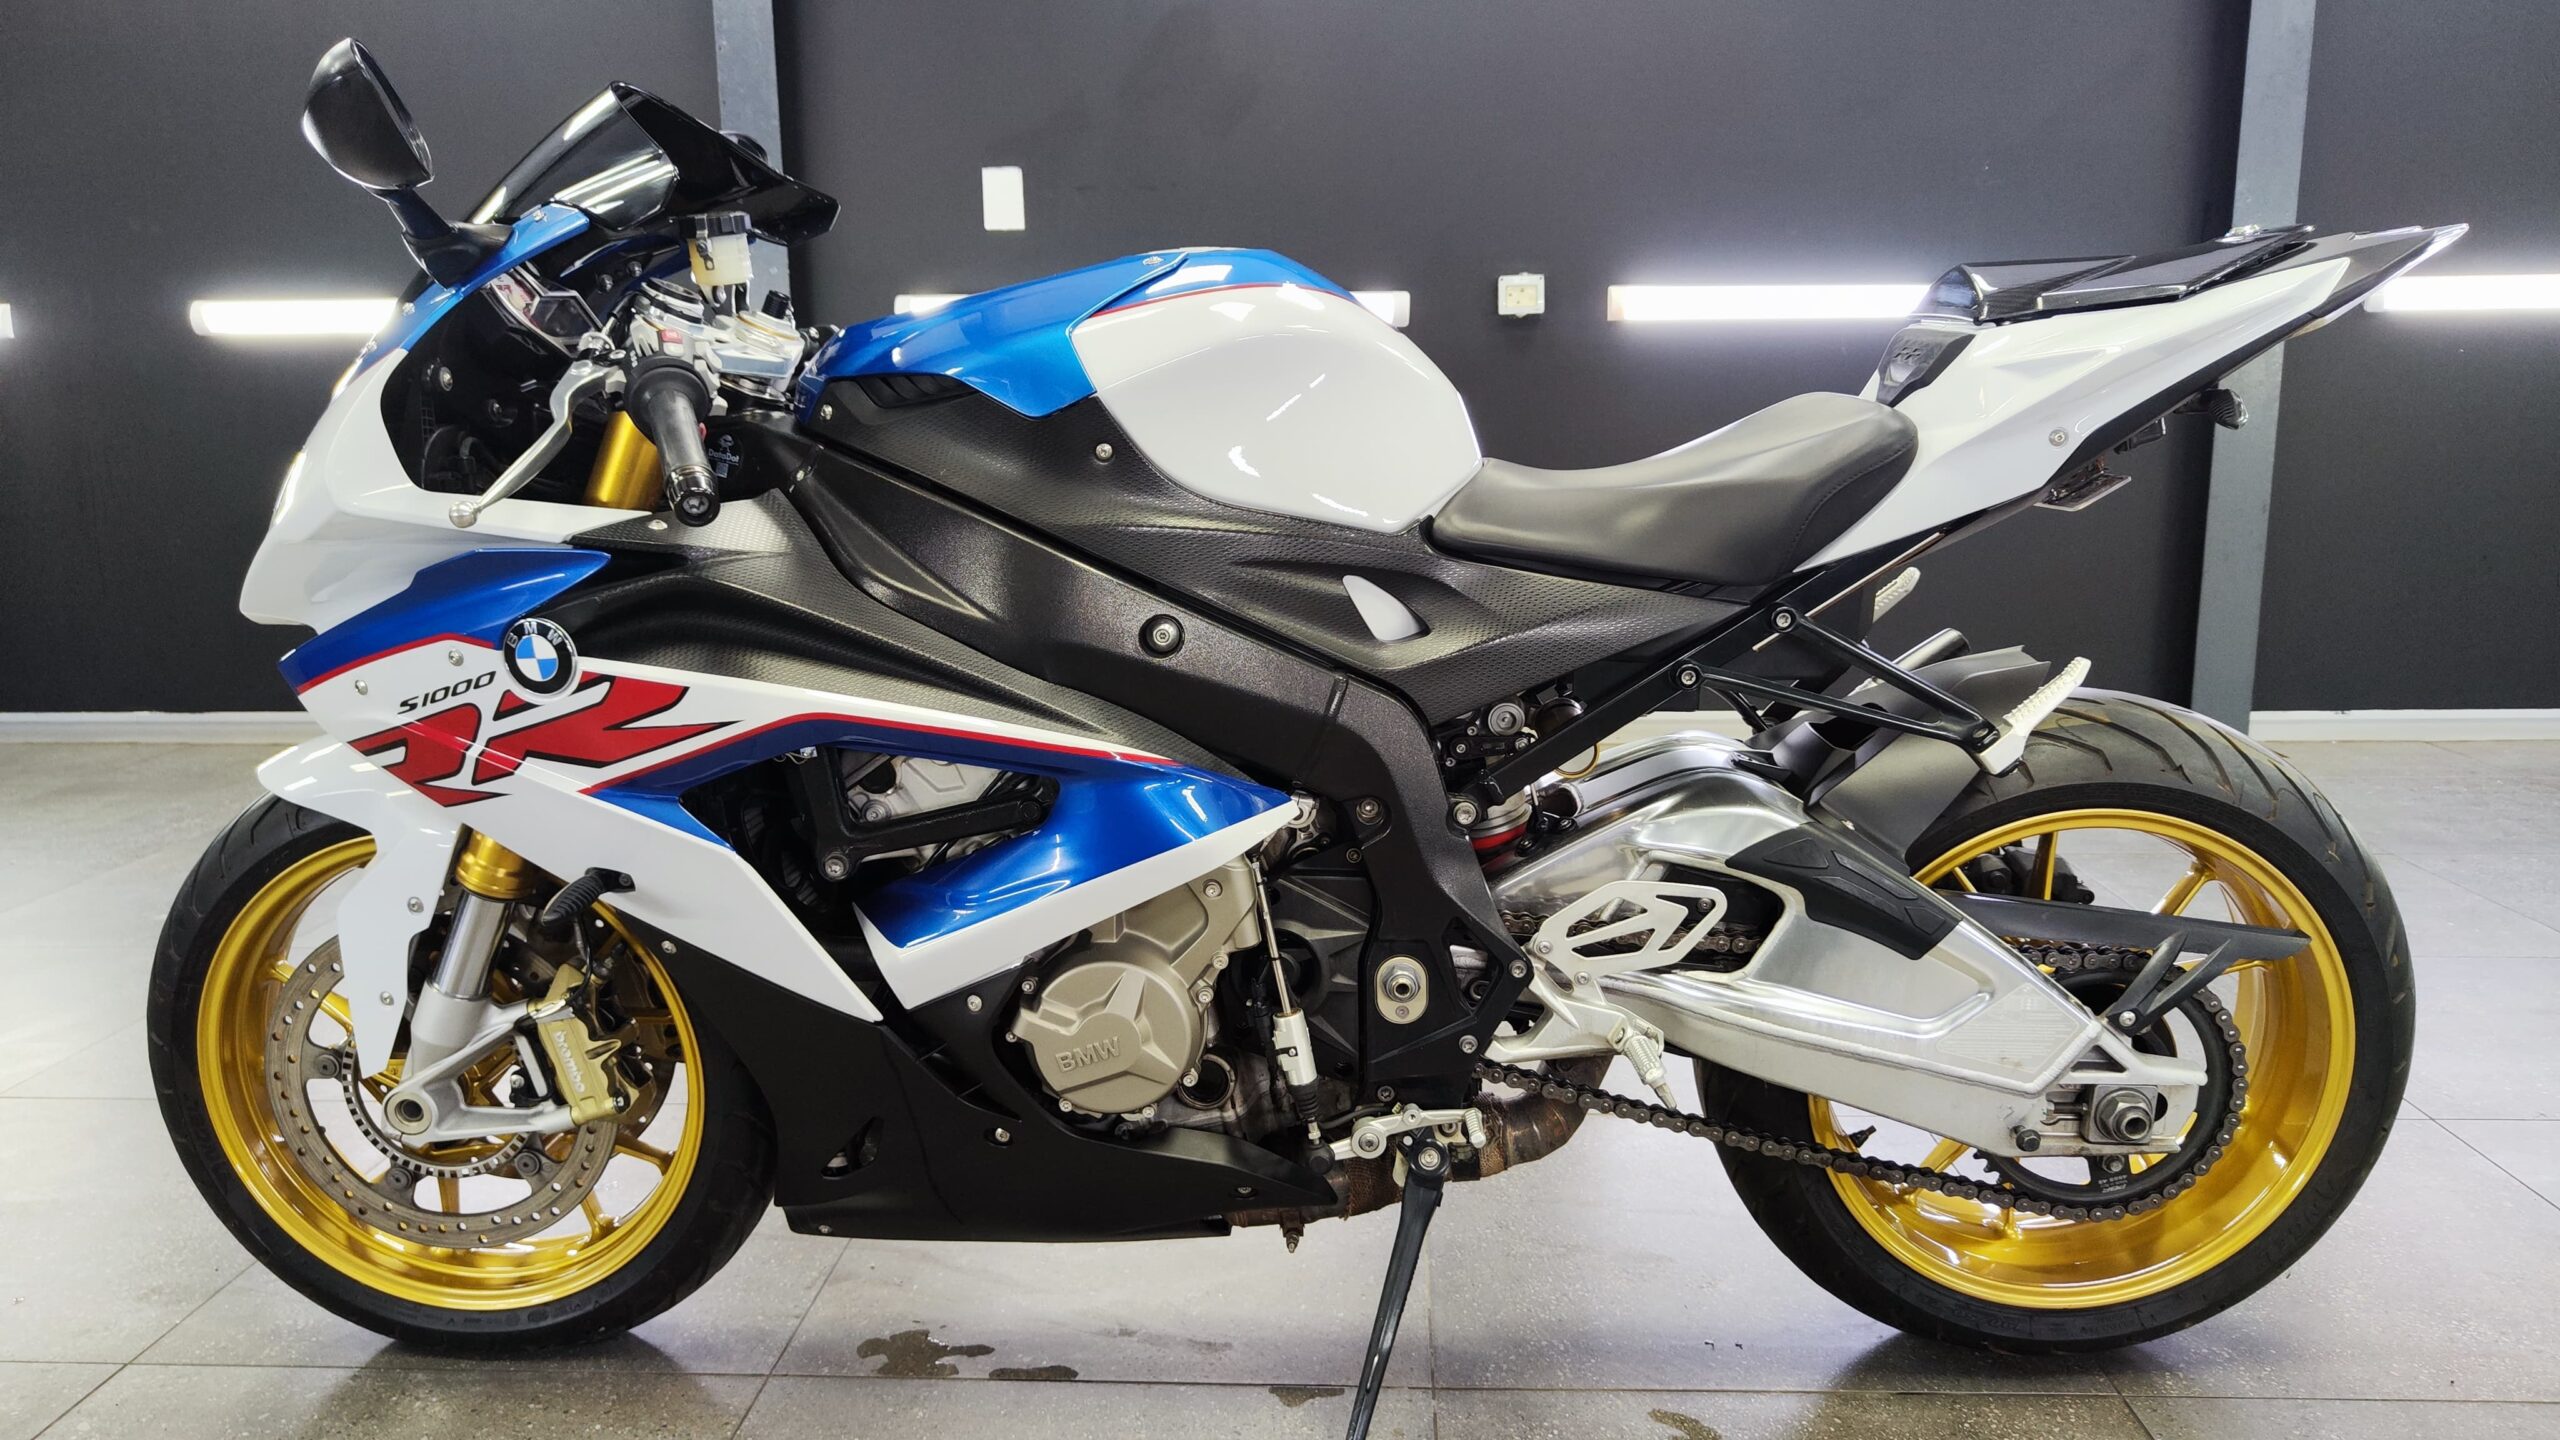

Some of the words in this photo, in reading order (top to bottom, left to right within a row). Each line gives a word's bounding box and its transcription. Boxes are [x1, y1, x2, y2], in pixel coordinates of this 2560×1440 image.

[506, 620, 563, 648] BMW
[397, 670, 497, 714] S1000
[348, 670, 744, 807] RR
[554, 1030, 586, 1093] brembo
[1055, 1036, 1120, 1072] BMW
